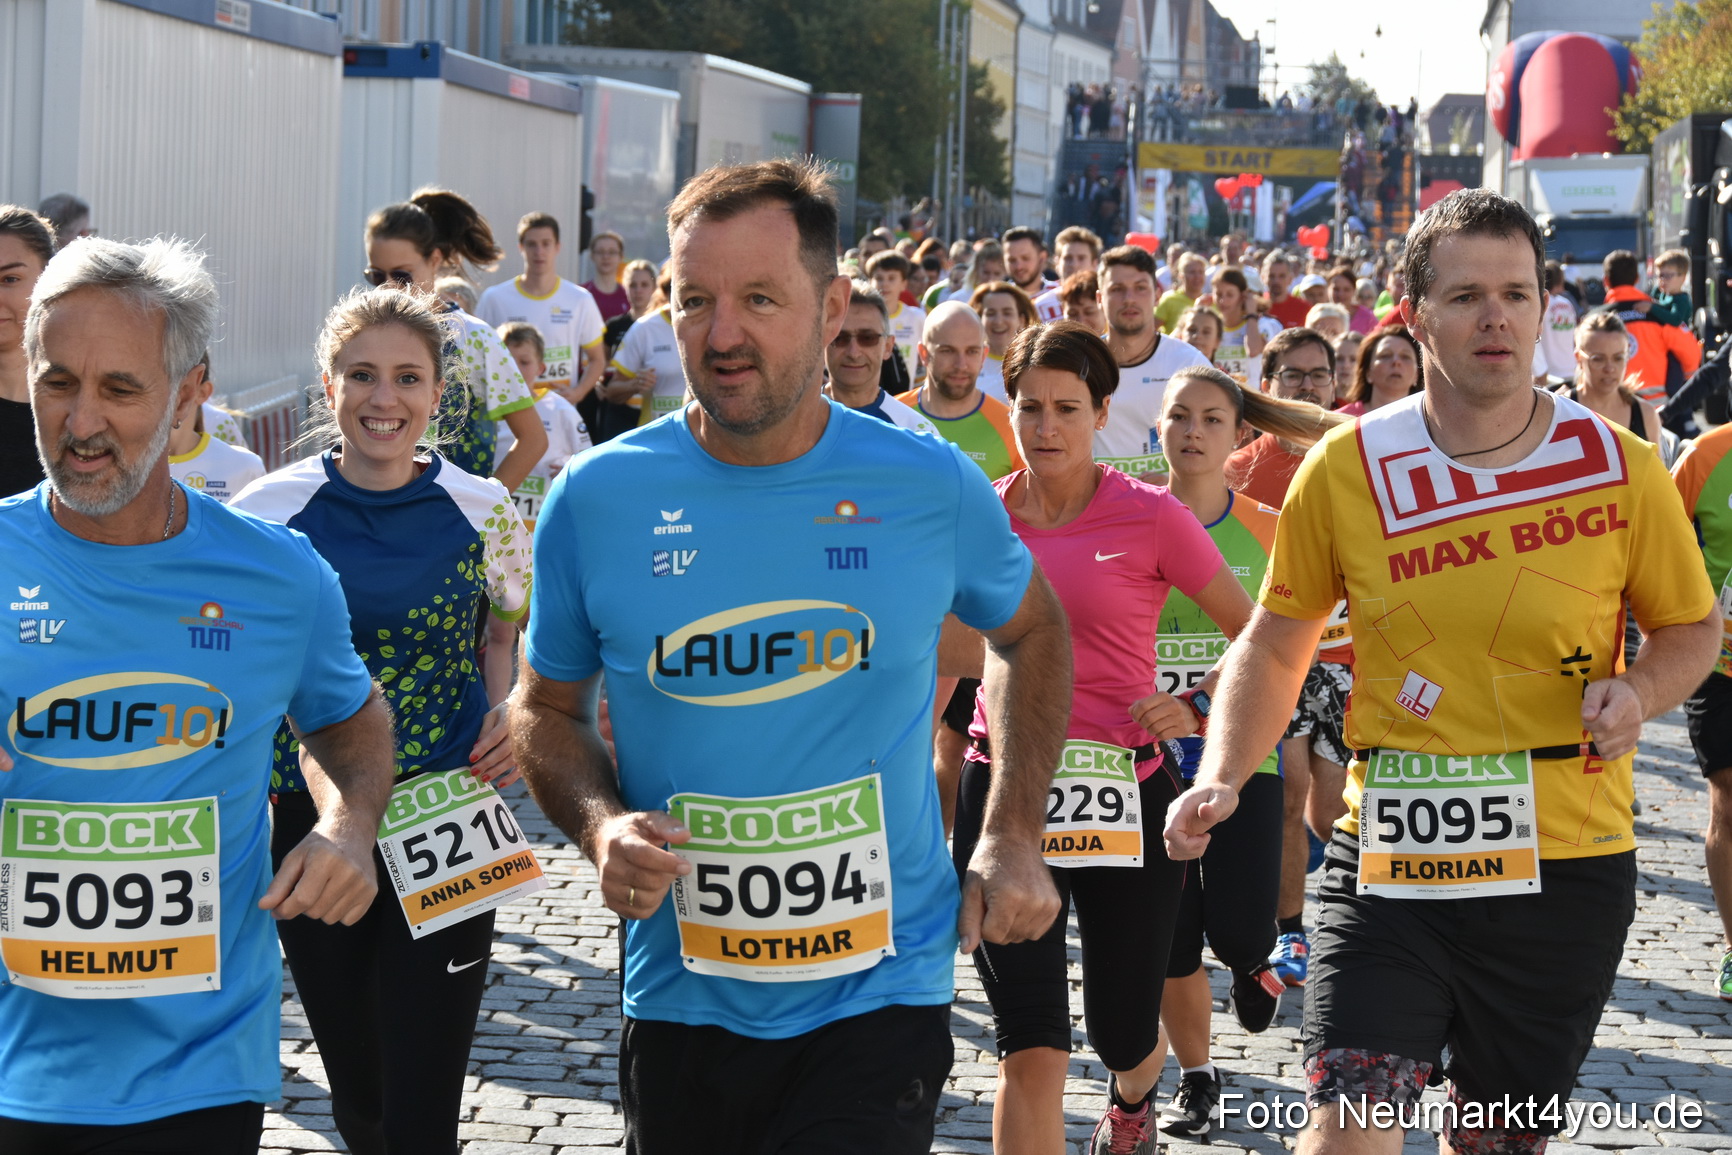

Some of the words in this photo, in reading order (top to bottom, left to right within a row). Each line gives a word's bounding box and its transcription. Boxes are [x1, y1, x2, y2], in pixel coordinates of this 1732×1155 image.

[1204, 149, 1273, 169] START
[539, 363, 567, 378] 46
[186, 476, 205, 488] 20
[653, 523, 692, 535] erima
[814, 516, 881, 525] ABENDSCHAU
[1388, 530, 1498, 583] MAX
[1510, 503, 1628, 554] BÖGL
[652, 549, 699, 577] BLV
[825, 547, 868, 570] TUM
[10, 601, 49, 611] erima
[19, 617, 67, 644] BLV
[178, 616, 244, 631] ABENDSCHAU
[187, 626, 231, 651] TUM
[655, 628, 870, 677] LAUF10!
[1156, 638, 1228, 661] OCK
[16, 697, 229, 749] LAUF10!
[1061, 746, 1126, 777] CK
[1376, 751, 1513, 782] BOCK
[386, 770, 490, 829] BOC
[1046, 784, 1124, 824] 229
[18, 809, 200, 852] BOCK
[685, 790, 866, 845] BOCK
[1377, 795, 1513, 844] 5095
[402, 803, 519, 881] 5210
[869, 849, 878, 860] S
[1041, 835, 1104, 853] ADJA
[1390, 857, 1504, 880] FLORIAN
[420, 878, 476, 911] ANNA
[479, 855, 534, 886] SOPHIA
[697, 851, 867, 918] 5094
[23, 869, 194, 930] 5093
[720, 929, 853, 960] LOTHAR
[41, 947, 178, 974] HELMUT
